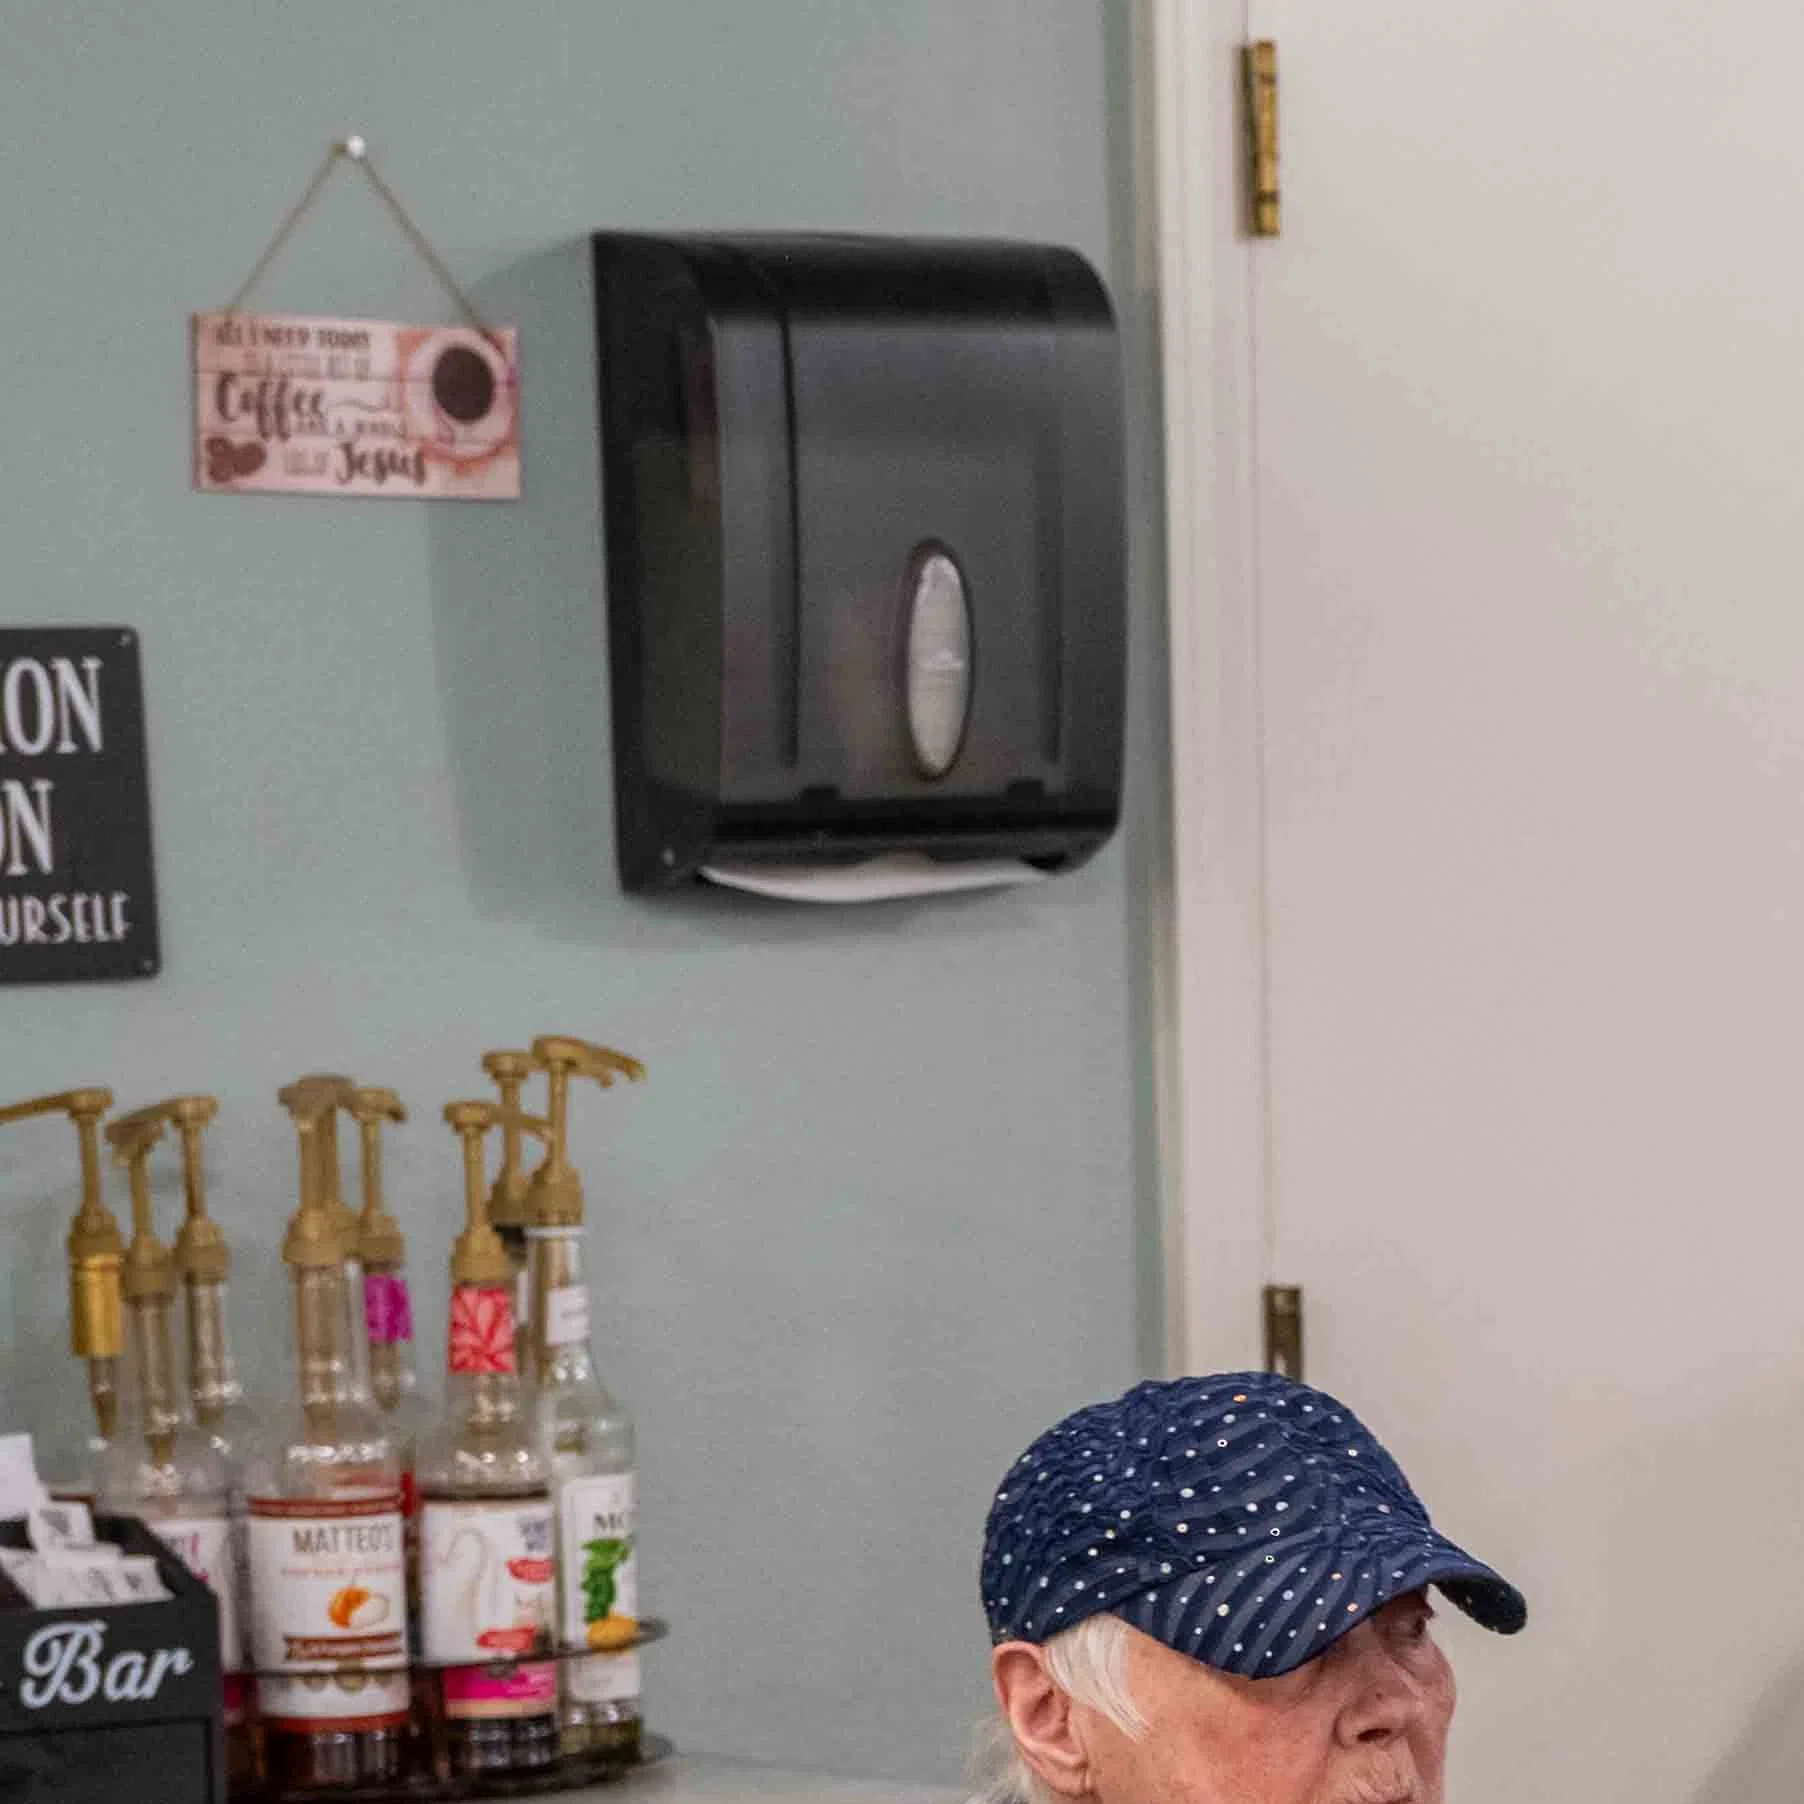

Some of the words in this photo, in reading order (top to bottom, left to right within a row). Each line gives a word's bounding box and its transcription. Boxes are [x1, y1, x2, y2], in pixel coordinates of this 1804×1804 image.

[215, 372, 325, 442] Coffee
[335, 441, 427, 486] Jesus
[0, 656, 104, 756] ON
[0, 778, 54, 877] N
[292, 1524, 394, 1553] MATTEO'S
[20, 1618, 196, 1709] Bar
